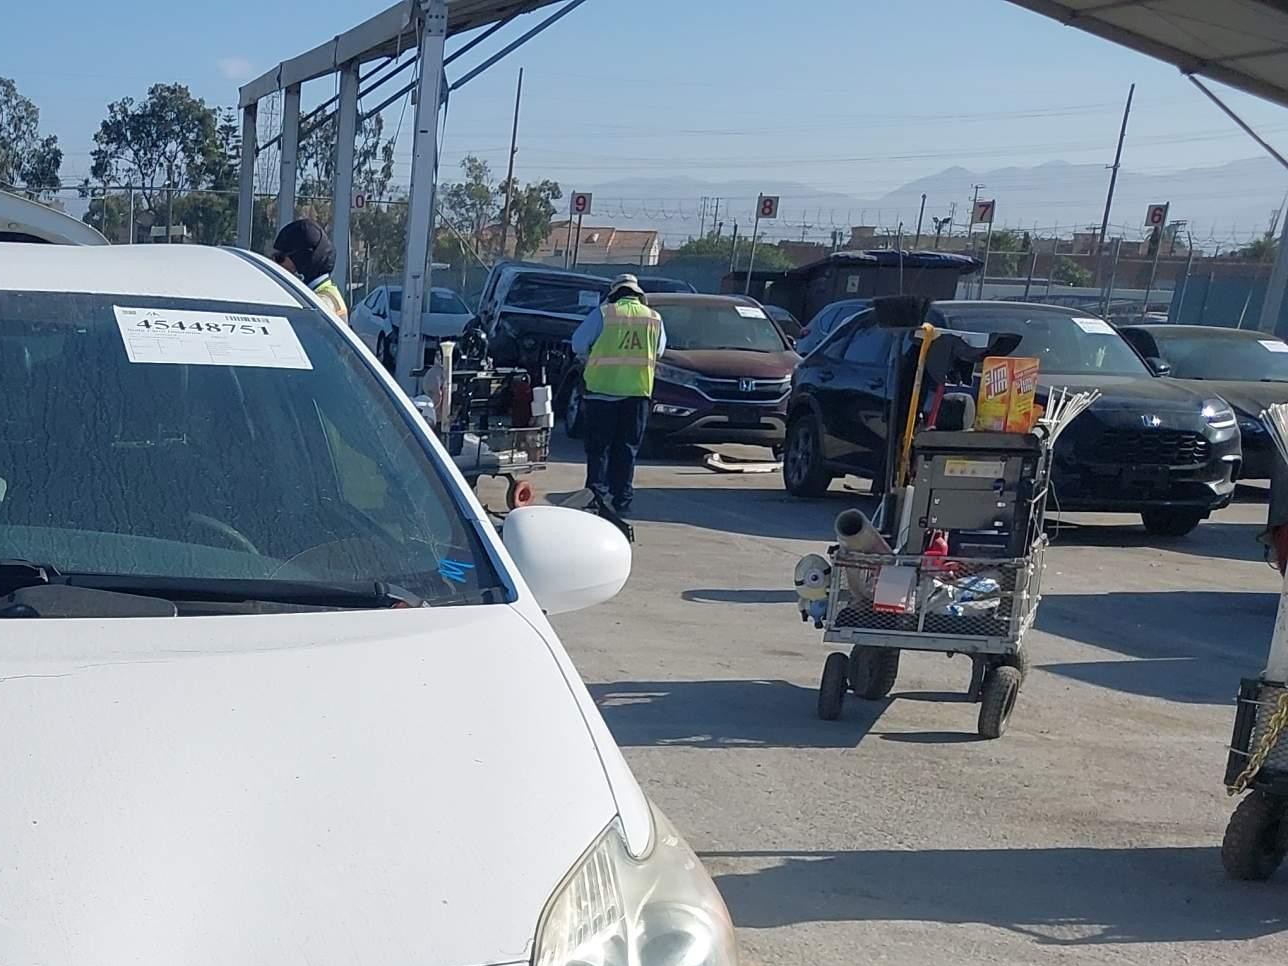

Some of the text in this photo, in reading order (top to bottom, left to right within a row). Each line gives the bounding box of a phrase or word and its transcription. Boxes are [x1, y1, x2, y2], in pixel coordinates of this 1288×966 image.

[575, 196, 586, 212] 9
[762, 198, 773, 216] 8
[978, 203, 992, 221] 7
[1150, 207, 1163, 224] 6
[136, 319, 271, 336] 45448751
